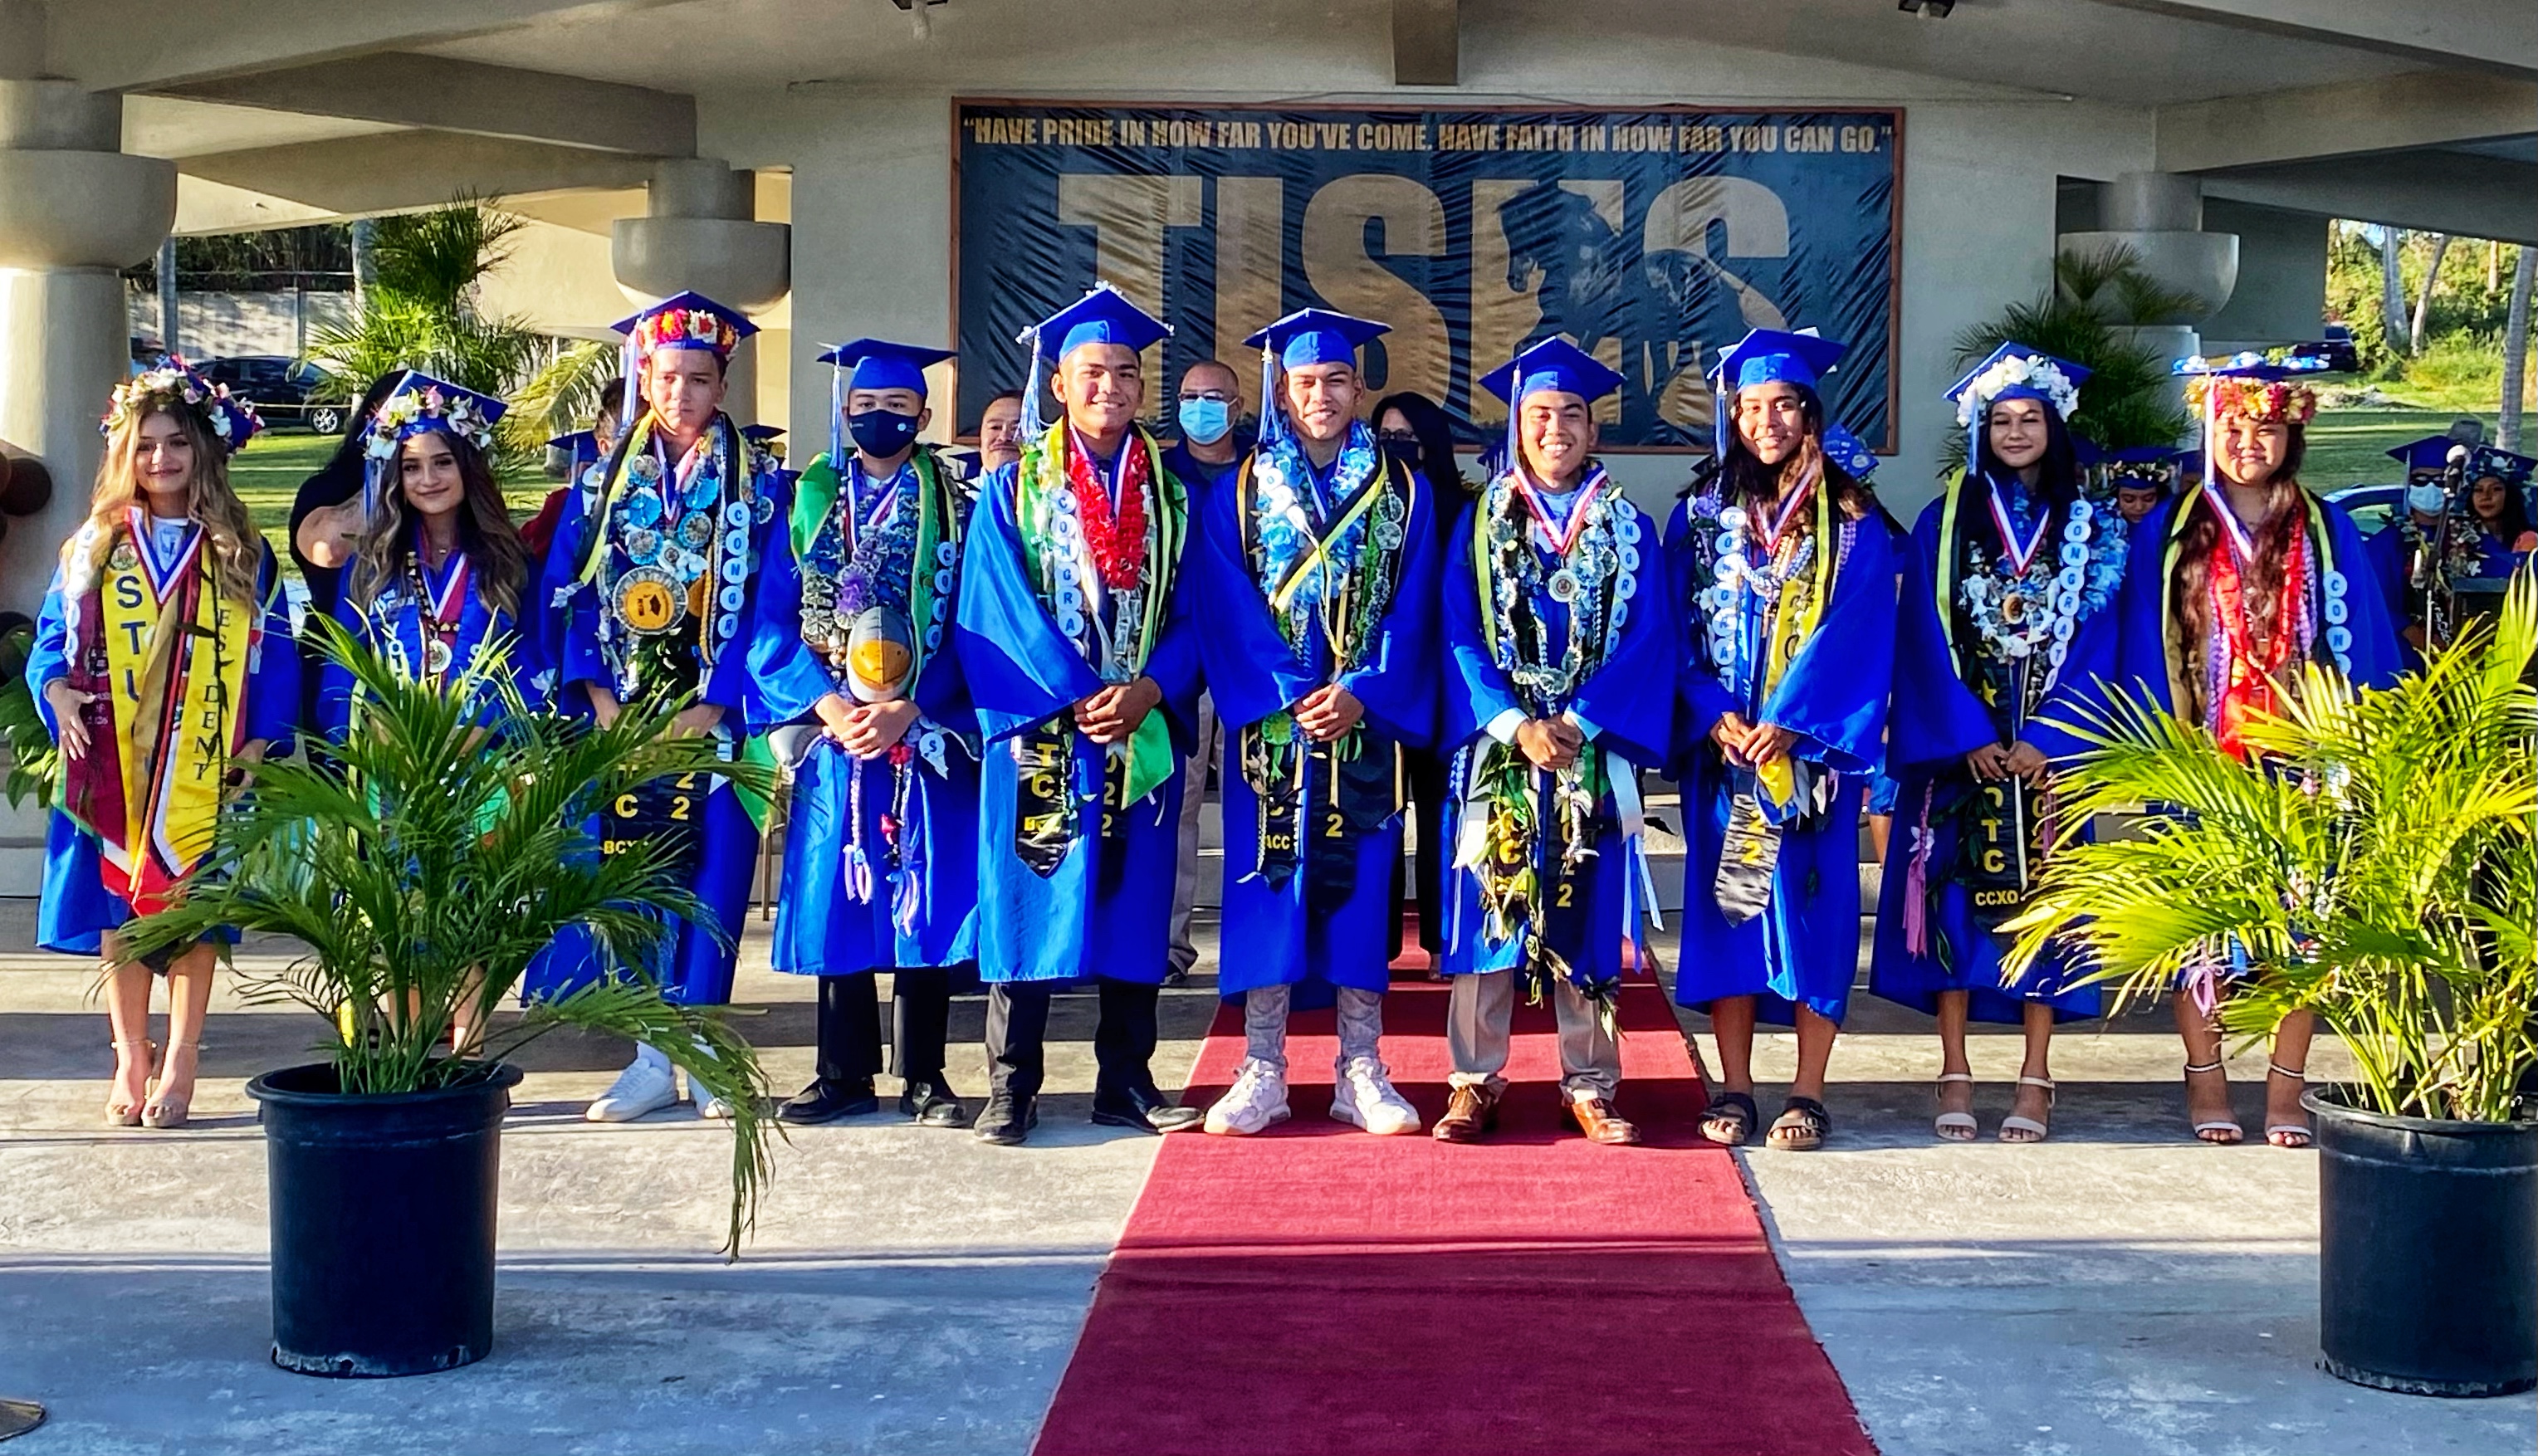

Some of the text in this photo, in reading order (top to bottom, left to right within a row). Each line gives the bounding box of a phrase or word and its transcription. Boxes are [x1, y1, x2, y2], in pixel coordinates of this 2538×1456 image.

[1043, 119, 1114, 146] PRIDE
[1121, 120, 1145, 147] IN
[1152, 120, 1211, 148] HOW
[1217, 122, 1261, 149] FAR
[1357, 124, 1433, 151] COME.
[1438, 125, 1499, 151] HAVE
[1506, 125, 1574, 152] FAITH
[1581, 125, 1606, 152] IN
[1611, 125, 1673, 152] HOW
[1679, 125, 1723, 152] FAR
[1729, 125, 1778, 152] YOU
[1785, 125, 1834, 153] CAN
[1974, 889, 2019, 907] CCXO
